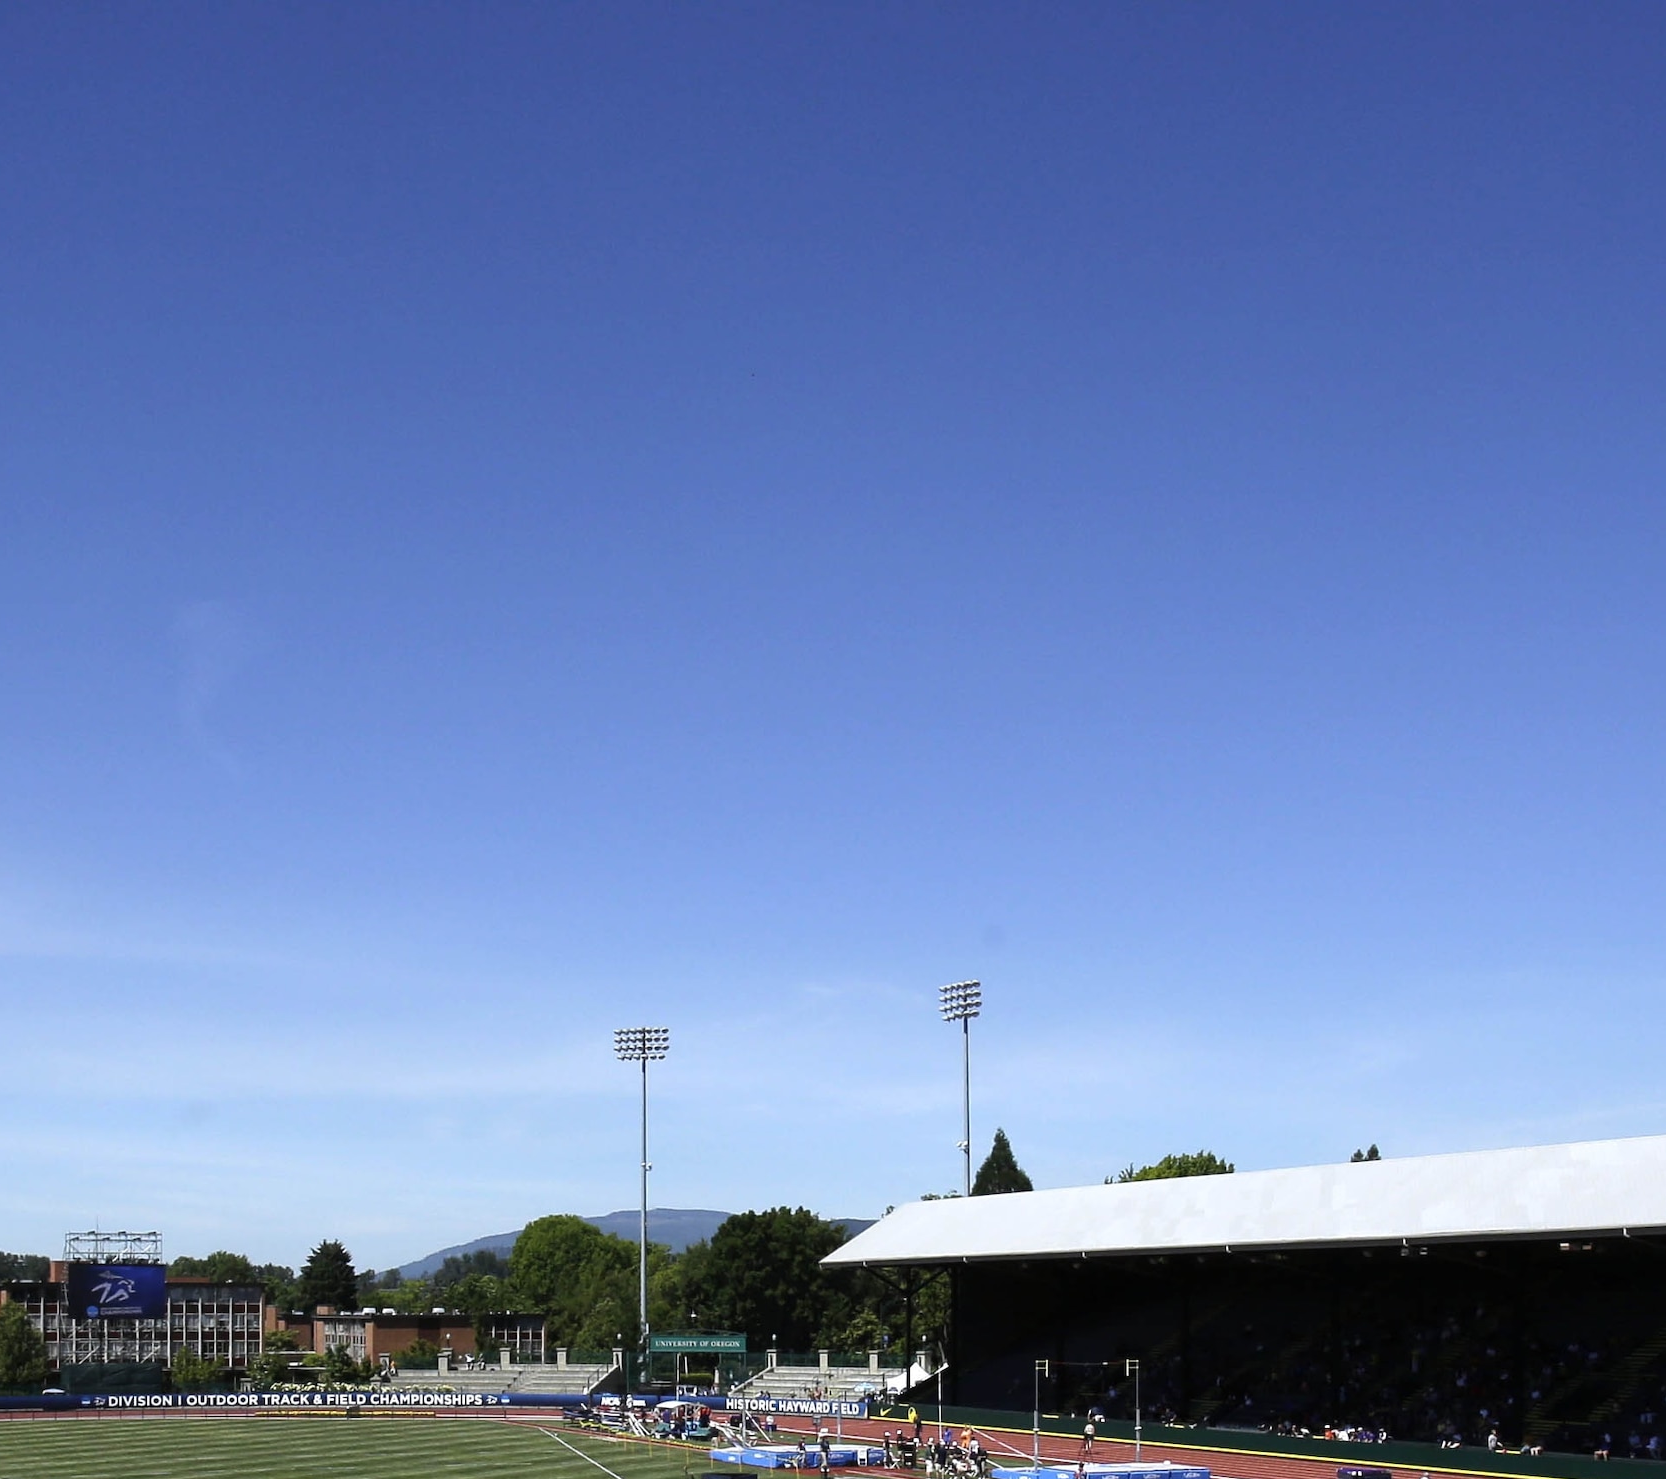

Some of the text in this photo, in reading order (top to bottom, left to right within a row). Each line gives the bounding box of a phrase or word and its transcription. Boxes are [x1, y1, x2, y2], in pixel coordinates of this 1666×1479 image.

[108, 1394, 483, 1406] DIVISION I OUTDOOR TRACK & FIELD CHAMPIONSHIPS
[726, 1398, 859, 1415] HISTORIC HAYWARD FELD
